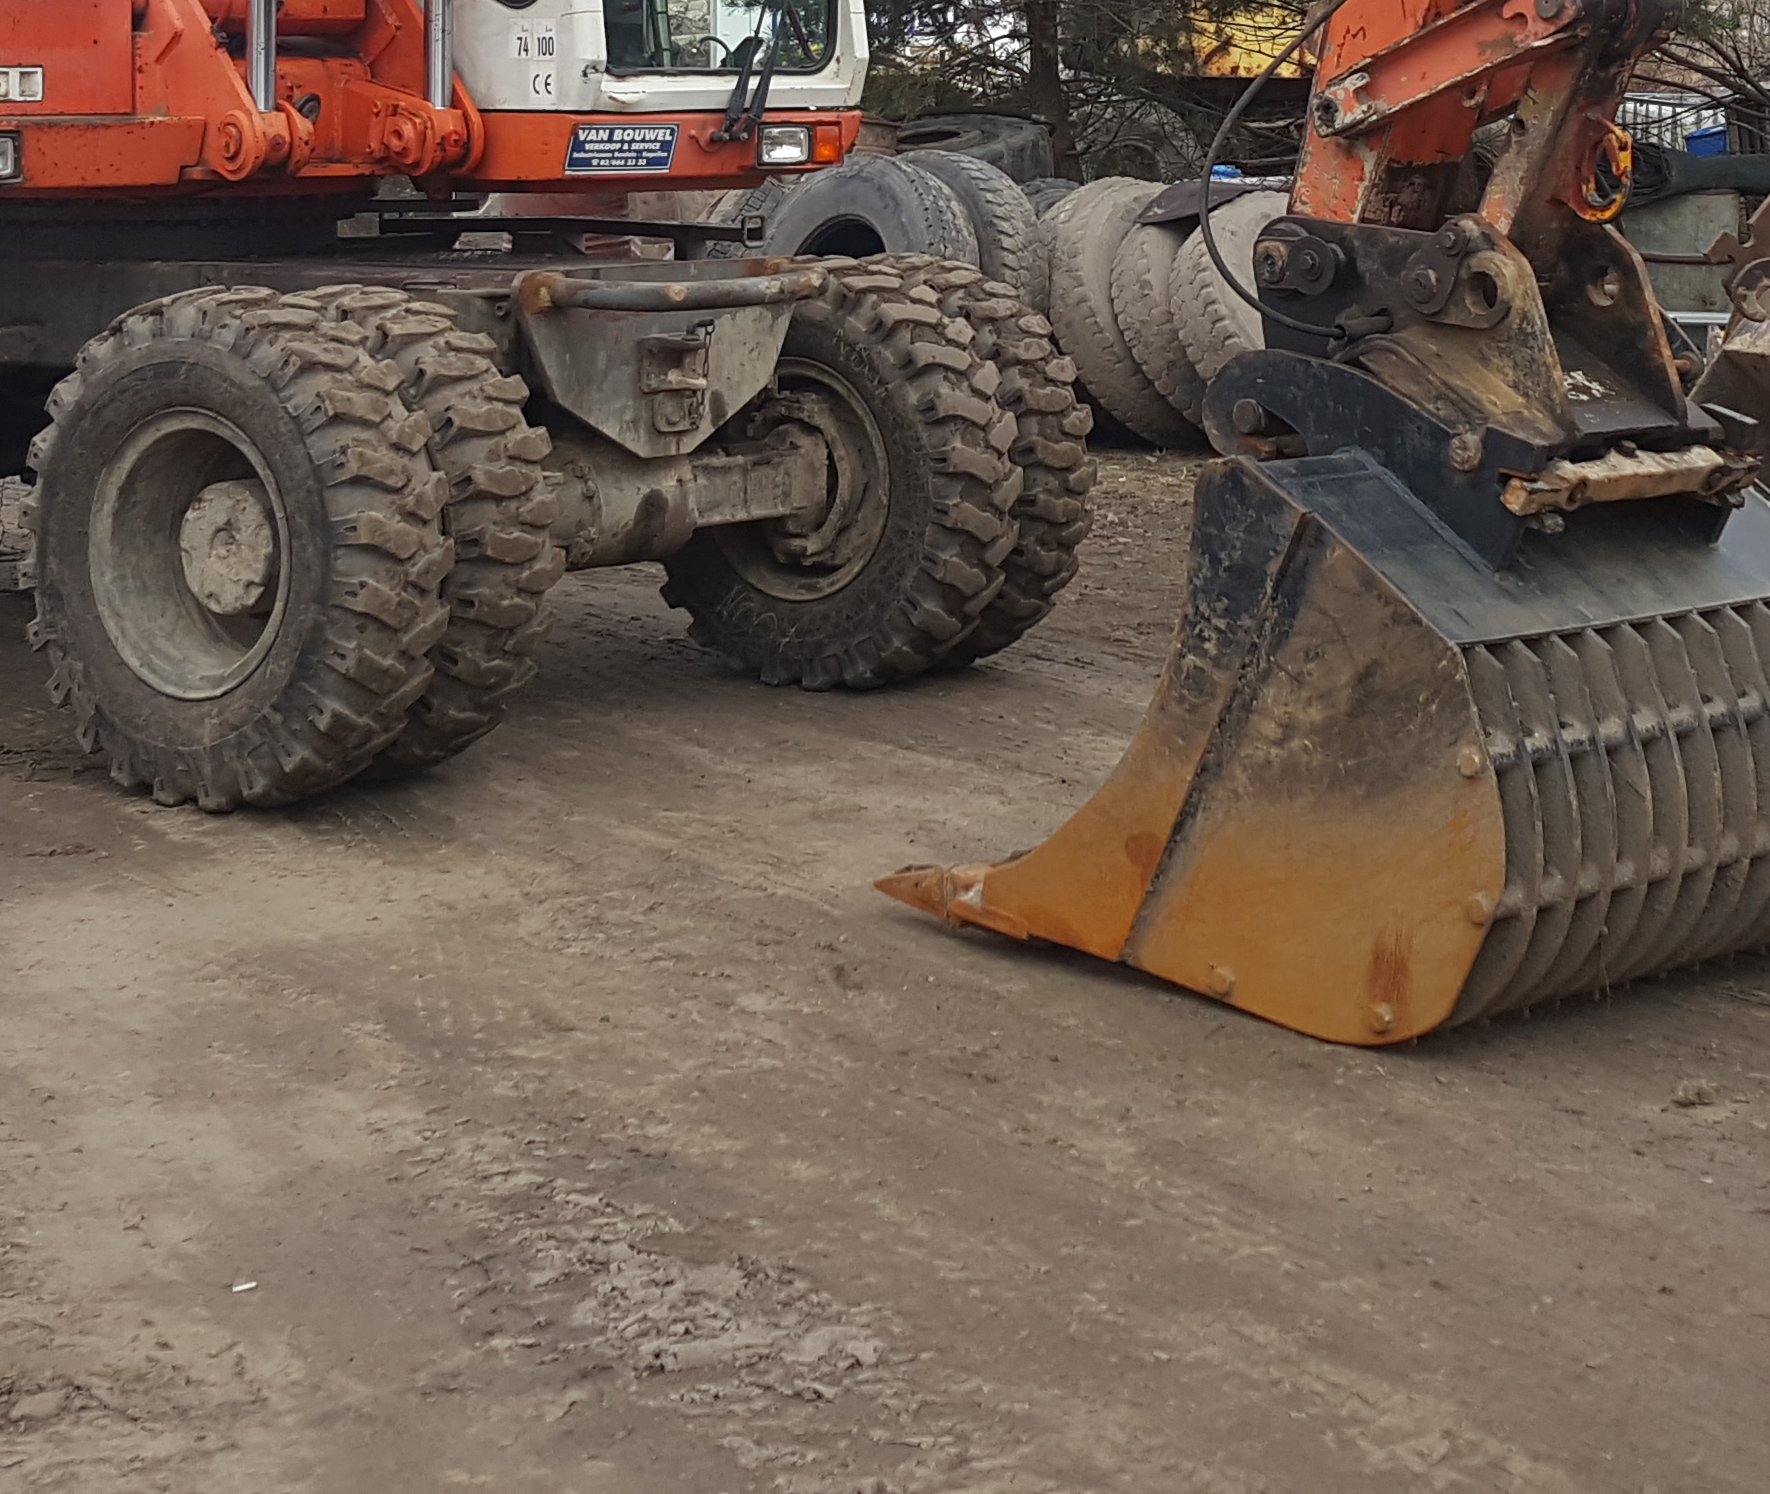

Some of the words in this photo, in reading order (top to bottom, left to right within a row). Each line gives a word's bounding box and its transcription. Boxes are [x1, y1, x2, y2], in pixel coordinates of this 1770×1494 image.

[516, 36, 529, 57] 74
[537, 36, 555, 57] 100
[532, 73, 553, 96] CE
[578, 129, 609, 141] VAN
[613, 128, 673, 141] BOUWEL
